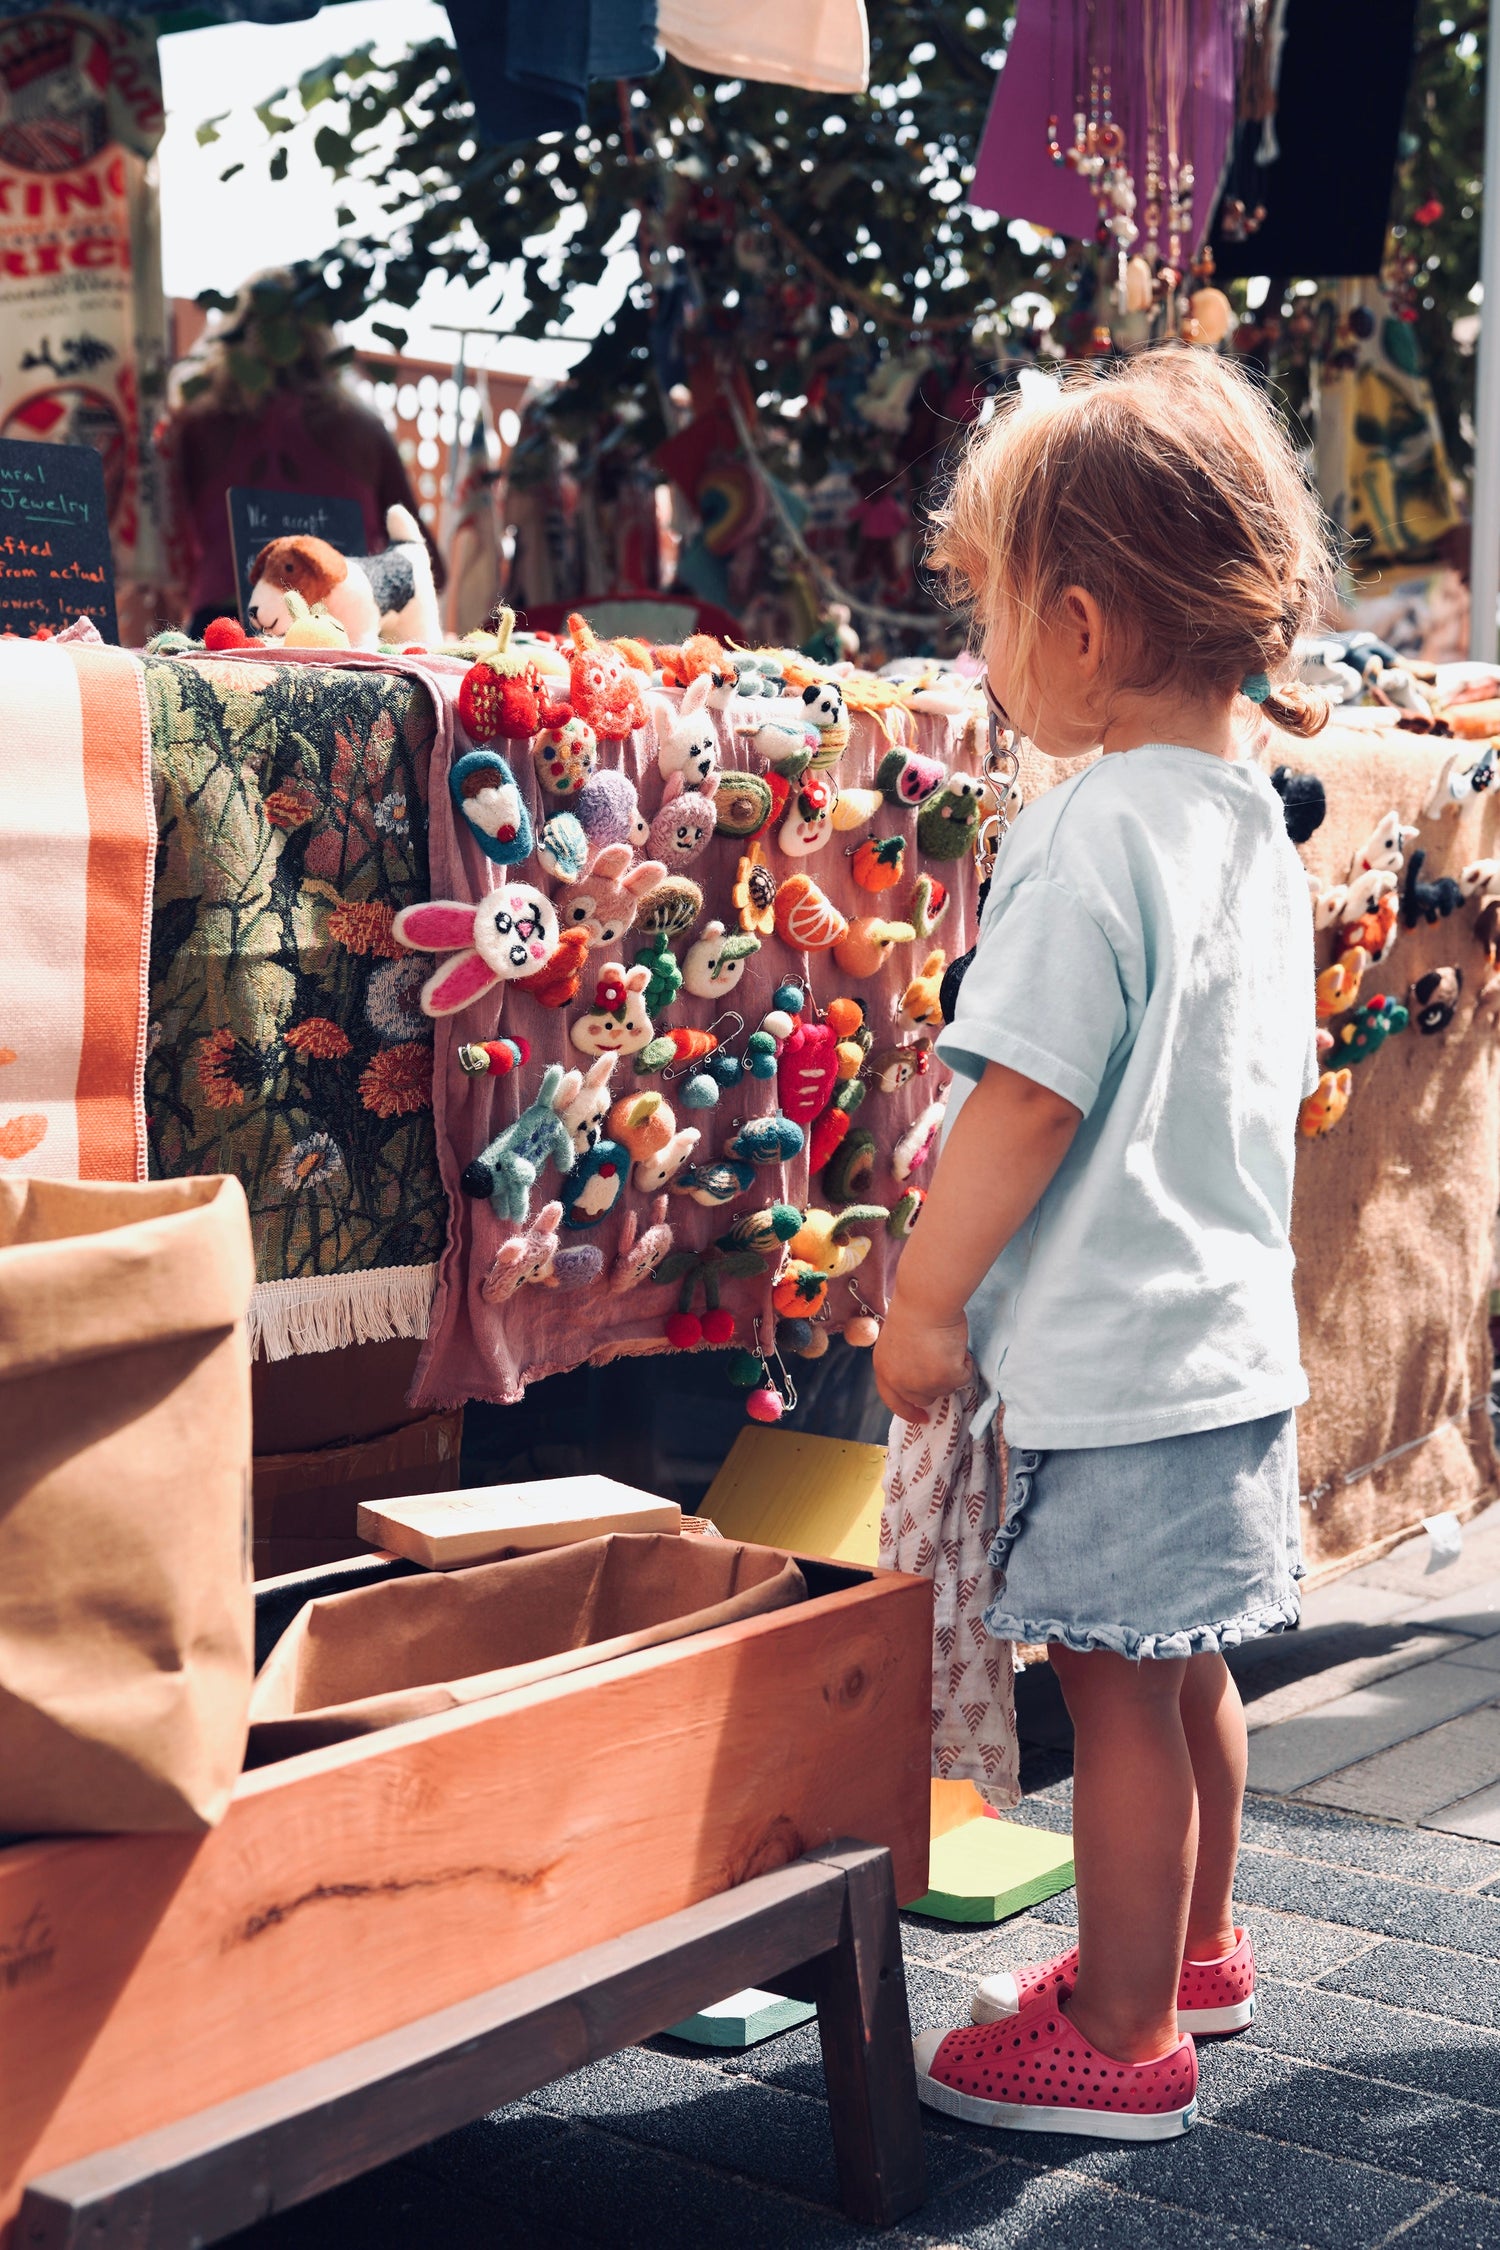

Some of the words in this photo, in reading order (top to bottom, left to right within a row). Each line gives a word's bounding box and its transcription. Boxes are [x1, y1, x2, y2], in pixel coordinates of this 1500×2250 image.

[0, 236, 130, 278] RIC
[1, 465, 46, 484] ural
[0, 487, 89, 523] Jewelry
[247, 503, 268, 527] We
[282, 507, 328, 535] accept
[49, 561, 106, 583] actual
[0, 598, 50, 615] owers,
[58, 597, 107, 618] leaves
